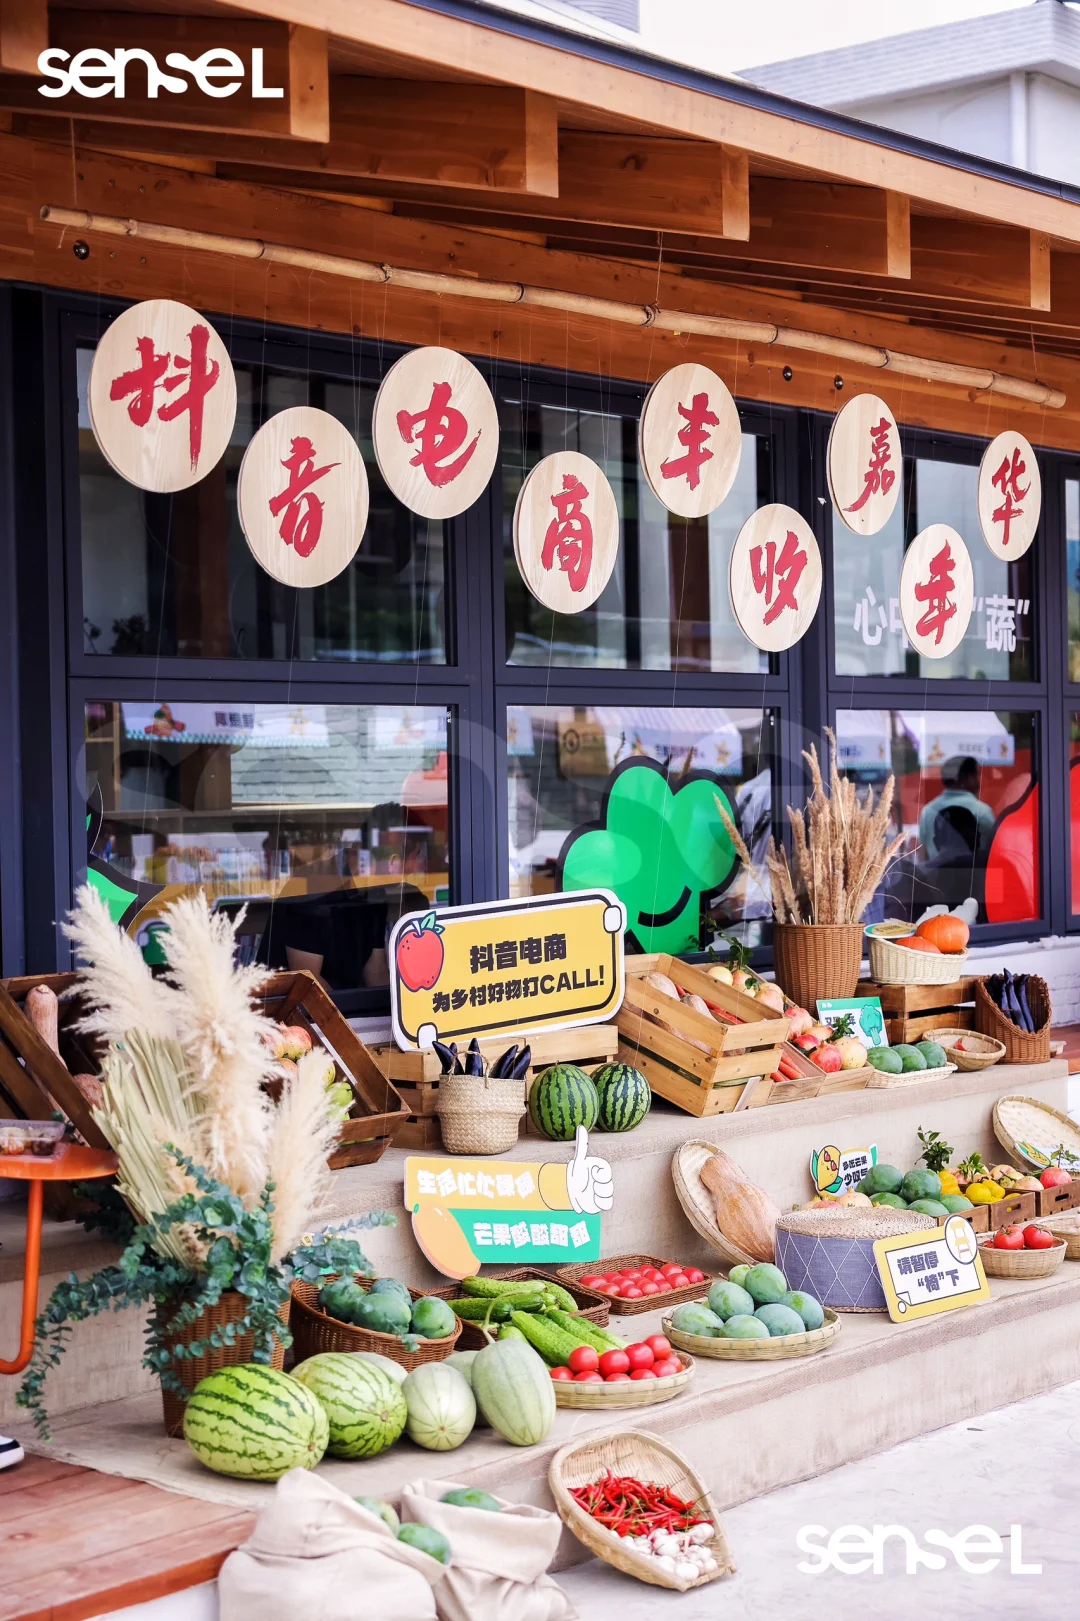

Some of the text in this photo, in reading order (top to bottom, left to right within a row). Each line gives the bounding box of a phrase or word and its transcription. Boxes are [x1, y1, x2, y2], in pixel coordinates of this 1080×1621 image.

[110, 324, 219, 475] 抖
[397, 382, 482, 487] 电
[660, 393, 720, 490] 丰
[270, 437, 341, 558] 音
[843, 417, 895, 513] 嘉
[992, 447, 1032, 545] 华
[541, 474, 593, 593] 商
[750, 531, 808, 626] 收
[915, 541, 957, 645] 年
[432, 965, 605, 1014] 为乡村好物打CALL!
[470, 933, 567, 974] 抖音电商
[417, 1168, 535, 1199] 生活忙忙碌碌
[842, 1155, 868, 1171] 多吃芒果
[473, 1220, 591, 1249] 芒果酸酸甜甜
[897, 1250, 939, 1276] 请暂停
